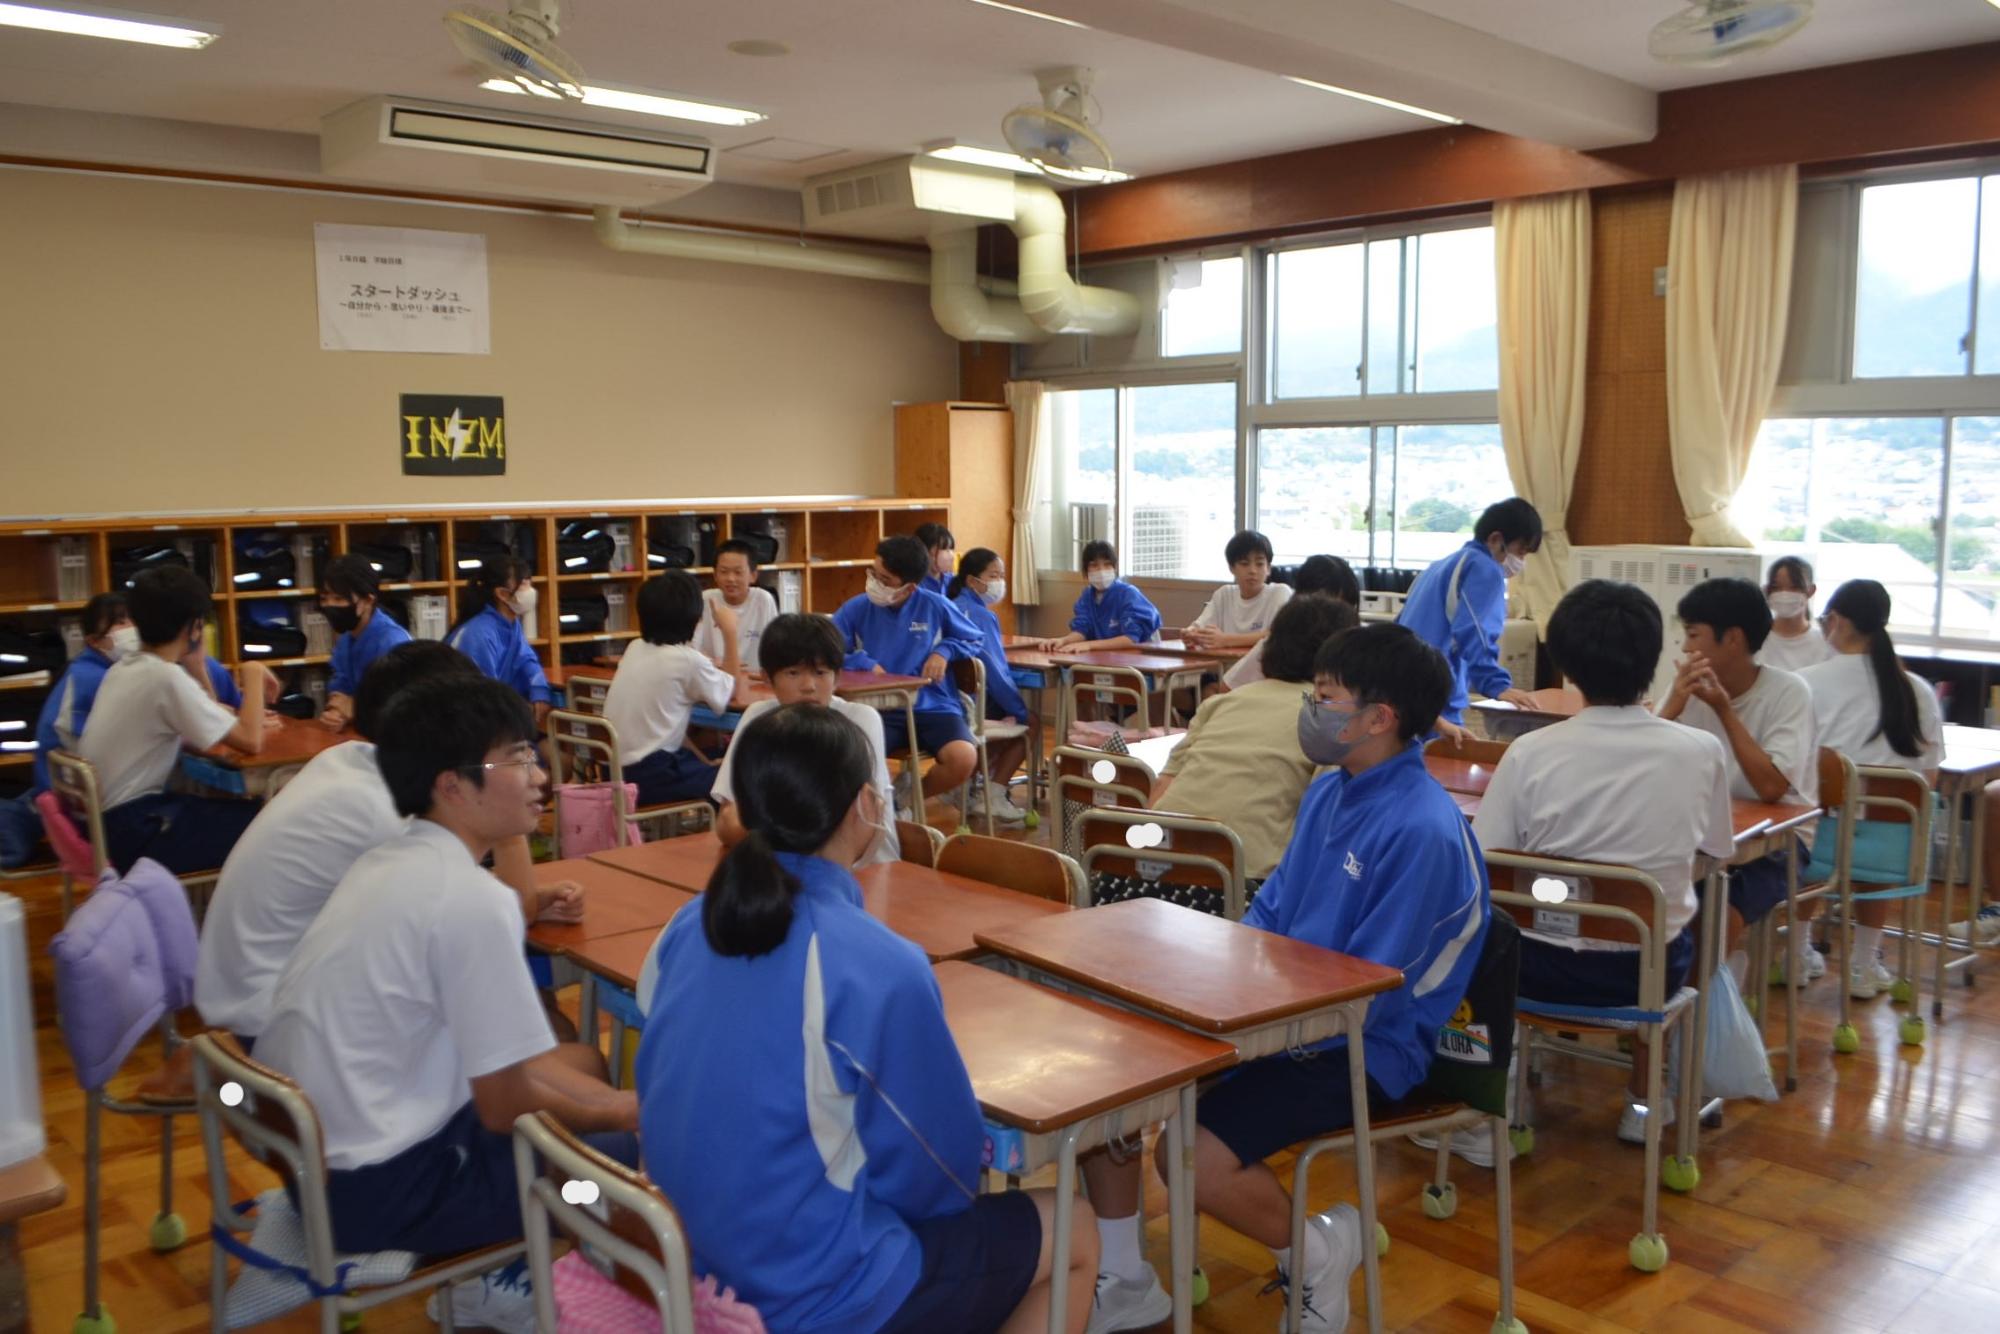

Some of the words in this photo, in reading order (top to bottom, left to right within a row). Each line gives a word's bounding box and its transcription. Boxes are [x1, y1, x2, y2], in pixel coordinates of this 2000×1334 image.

[350, 283, 461, 302] スタートダッシュ
